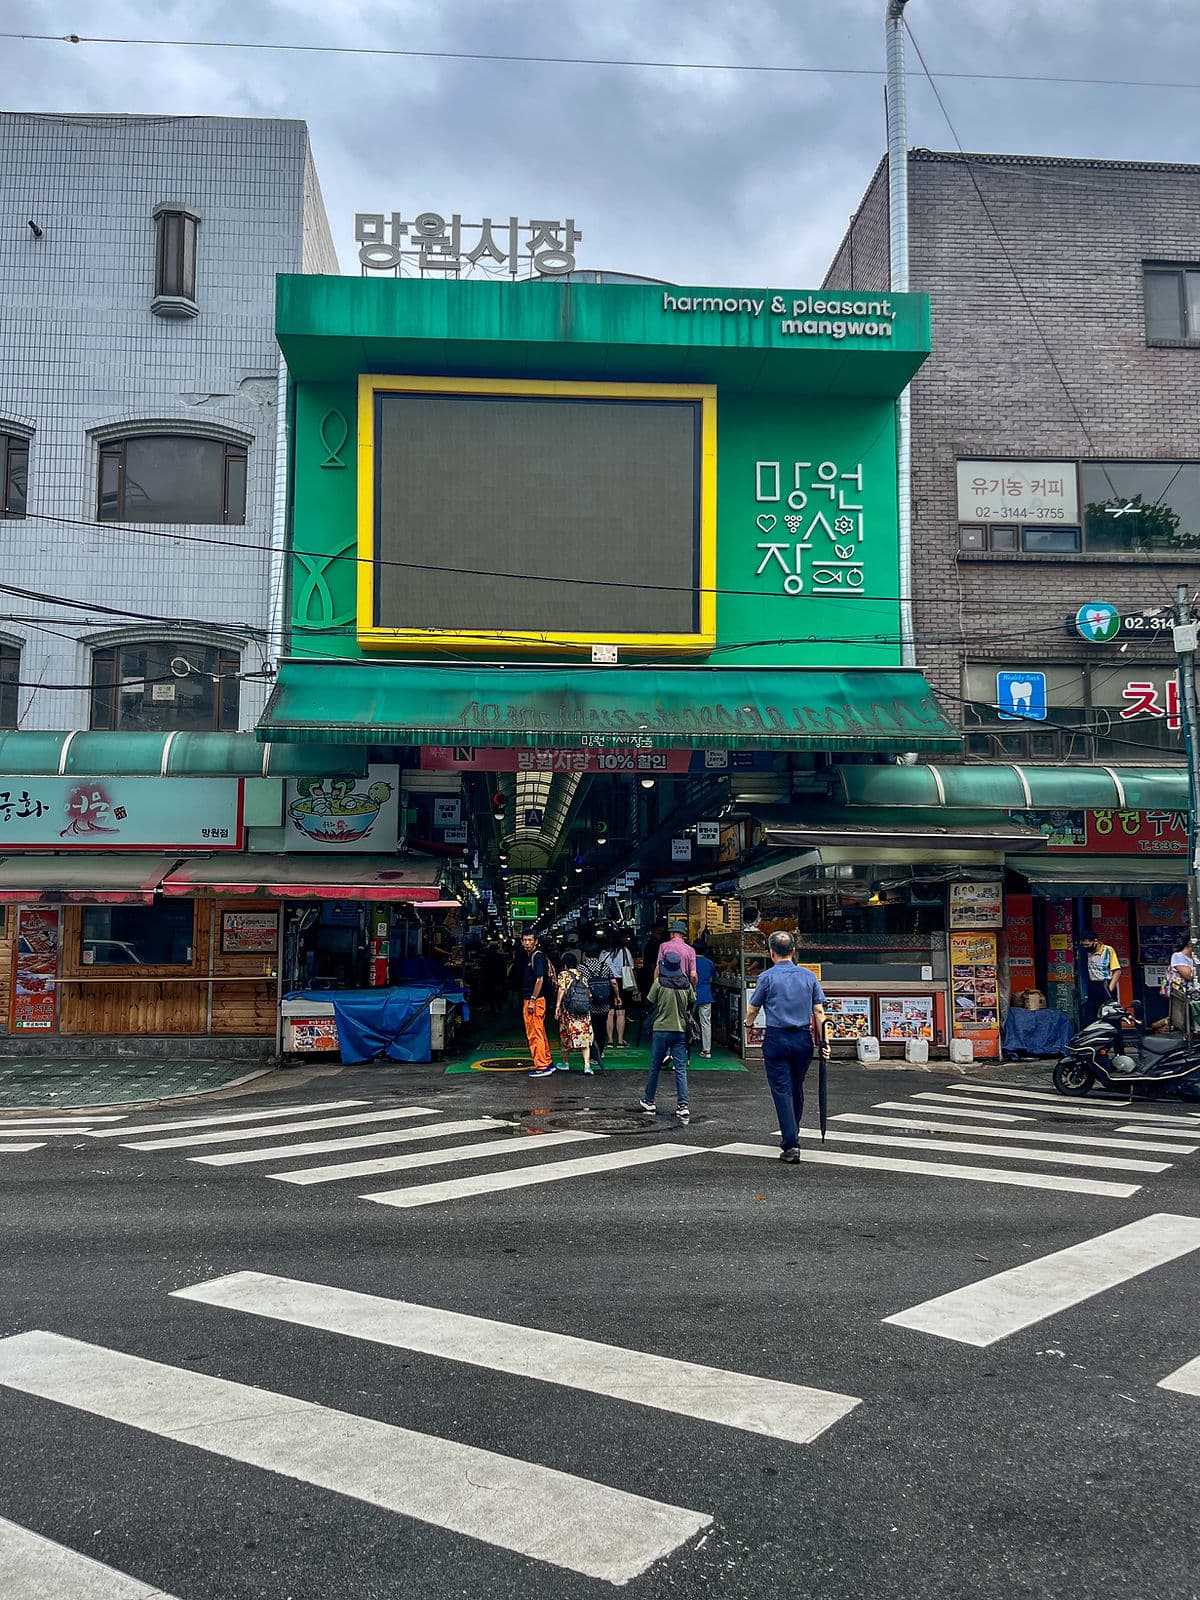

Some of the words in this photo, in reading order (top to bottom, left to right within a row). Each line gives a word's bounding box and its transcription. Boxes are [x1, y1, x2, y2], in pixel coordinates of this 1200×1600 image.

[355, 212, 582, 275] 망원시장
[663, 292, 765, 317] harmony
[771, 296, 787, 314] &
[793, 295, 897, 319] pleasant,
[781, 318, 892, 339] mangwon
[971, 477, 1023, 497] 유기농
[1031, 478, 1064, 497] 커피
[975, 507, 1065, 519] 02-3144-3755
[518, 752, 590, 770] 망원시장
[597, 753, 633, 770] 10%
[637, 753, 667, 770] 할인
[528, 811, 539, 823] A
[202, 828, 229, 838] 망원점
